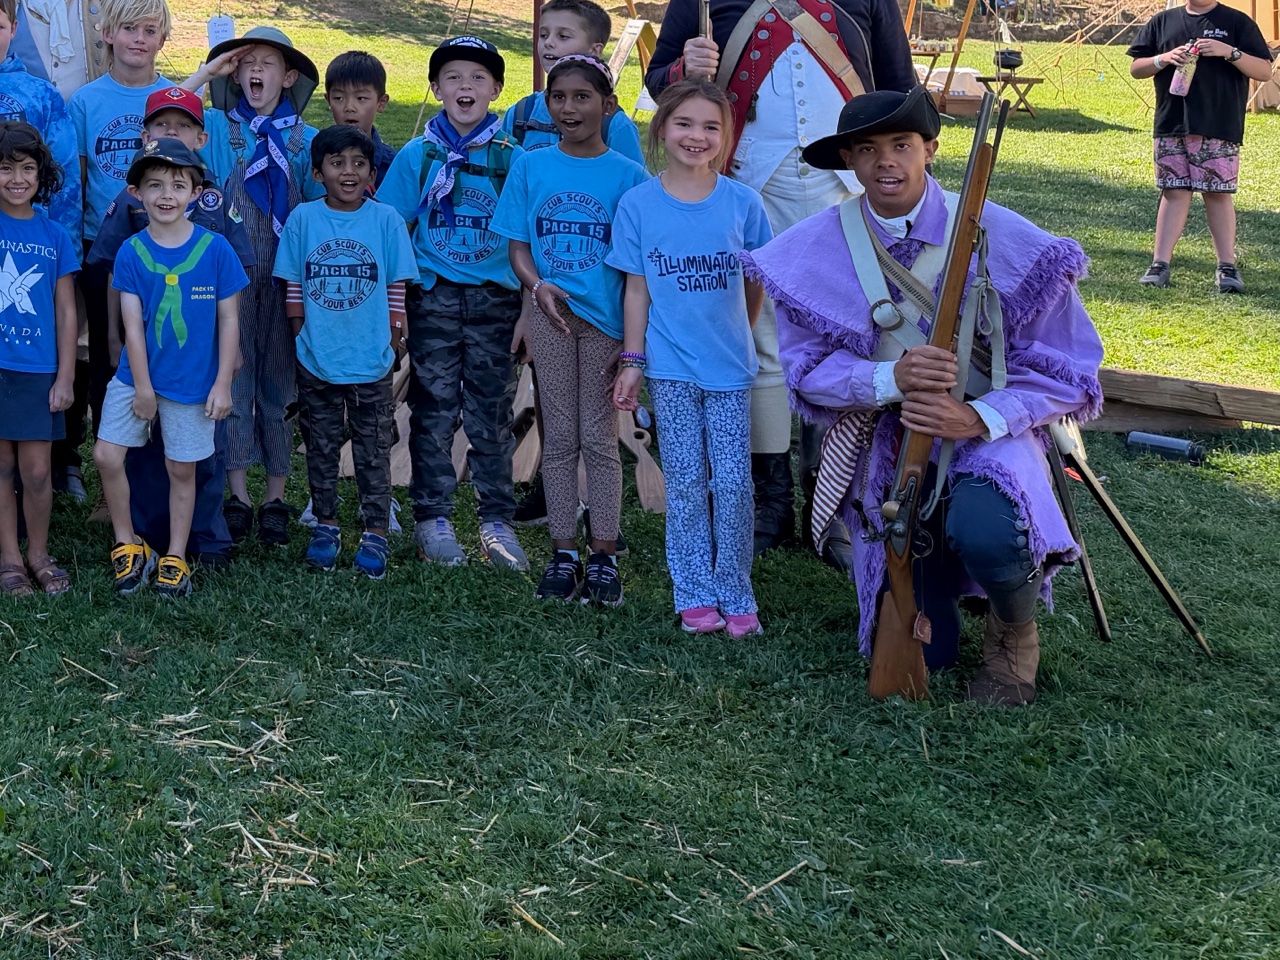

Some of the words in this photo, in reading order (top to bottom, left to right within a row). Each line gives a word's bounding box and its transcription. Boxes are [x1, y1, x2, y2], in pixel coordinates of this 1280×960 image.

[107, 119, 122, 132] CUB
[123, 116, 144, 125] SCOU
[101, 139, 136, 152] PACK
[112, 169, 127, 179] YOU
[547, 195, 564, 209] CUB
[566, 193, 602, 214] SCOUTS
[435, 212, 473, 227] PCK
[542, 220, 581, 234] PACK
[588, 224, 605, 239] 15
[316, 242, 332, 256] CUB
[334, 240, 368, 256] SCOUTS
[434, 240, 445, 252] DO
[447, 249, 471, 263] YOUR
[474, 244, 495, 262] BEST
[551, 258, 574, 271] YOUR
[578, 252, 600, 270] BEST
[310, 264, 350, 277] PACK
[355, 265, 371, 277] 15
[309, 289, 322, 301] DO
[322, 298, 345, 309] YOUR
[347, 290, 367, 308] BEST
